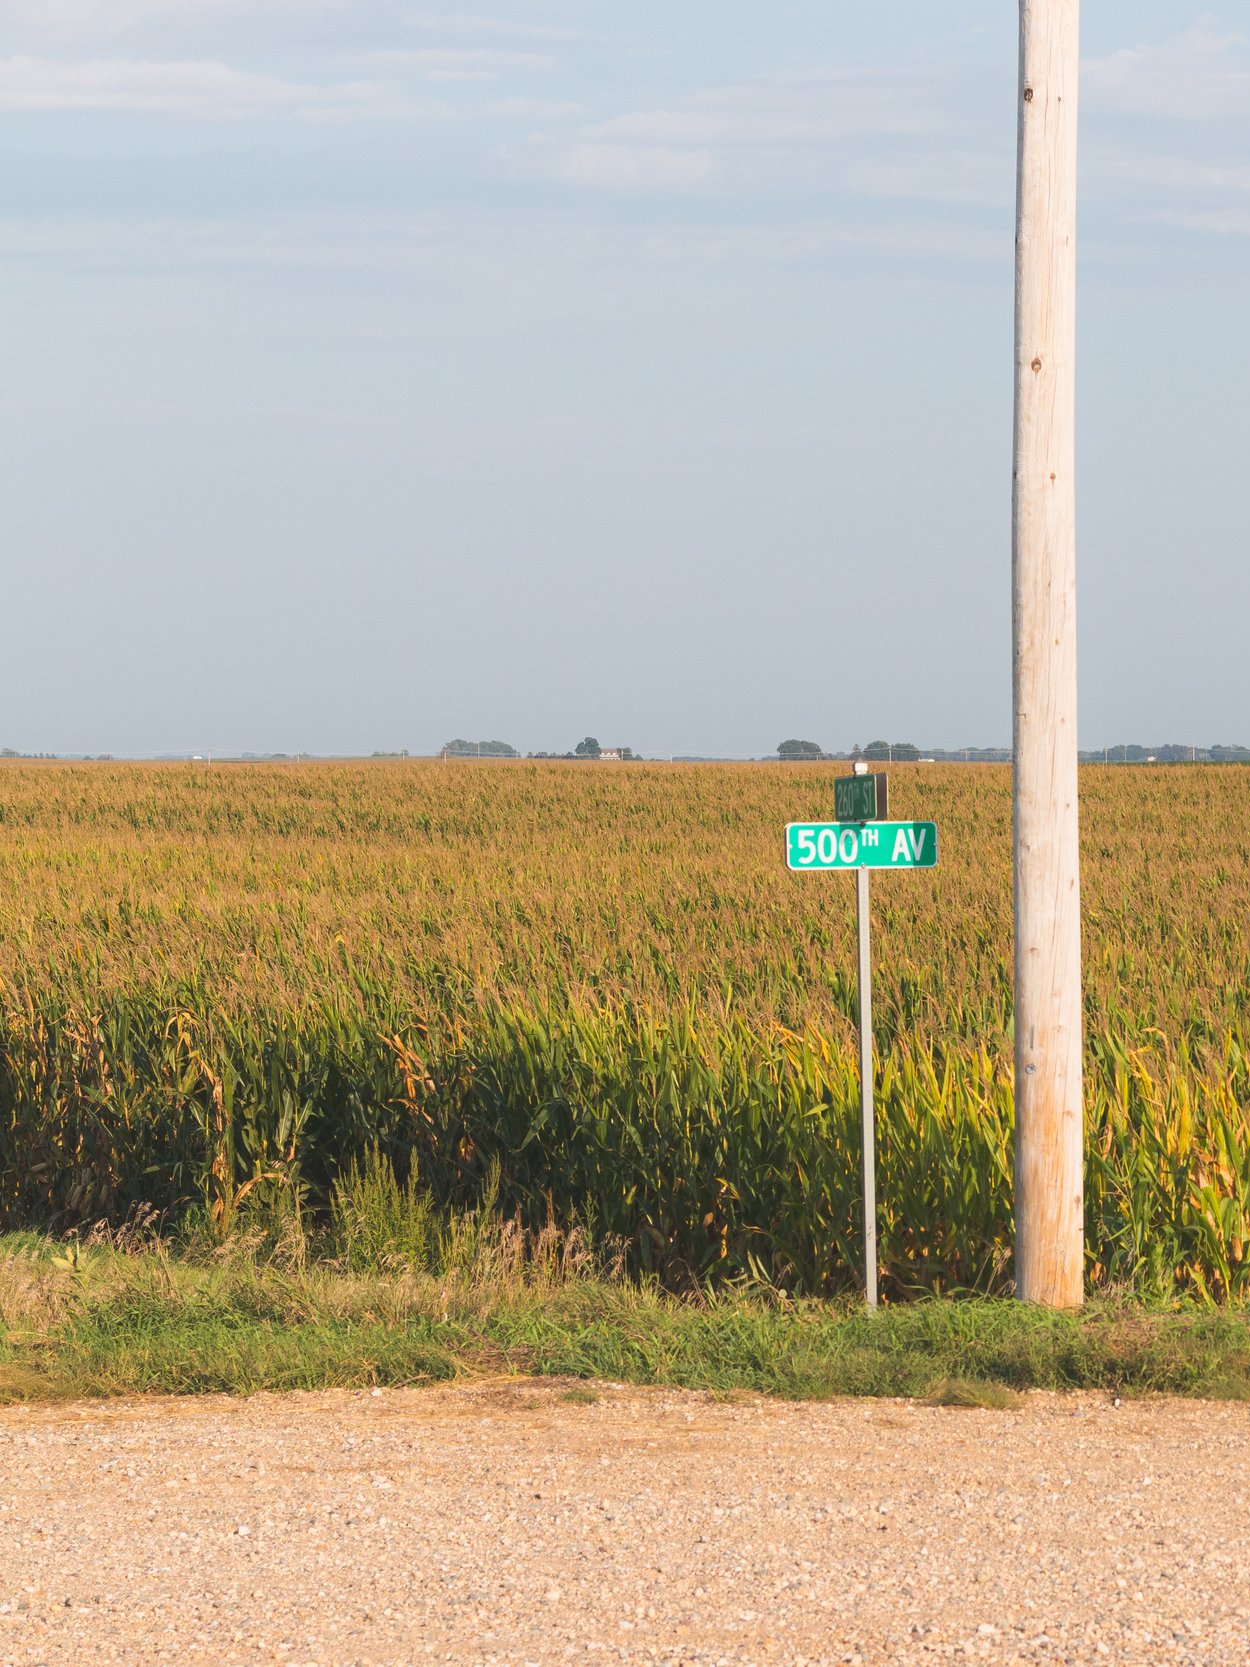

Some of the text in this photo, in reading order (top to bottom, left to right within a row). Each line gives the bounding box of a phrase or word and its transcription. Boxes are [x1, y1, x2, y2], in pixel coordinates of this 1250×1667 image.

[863, 781, 873, 815] ST
[797, 828, 926, 864] 500TH AV
